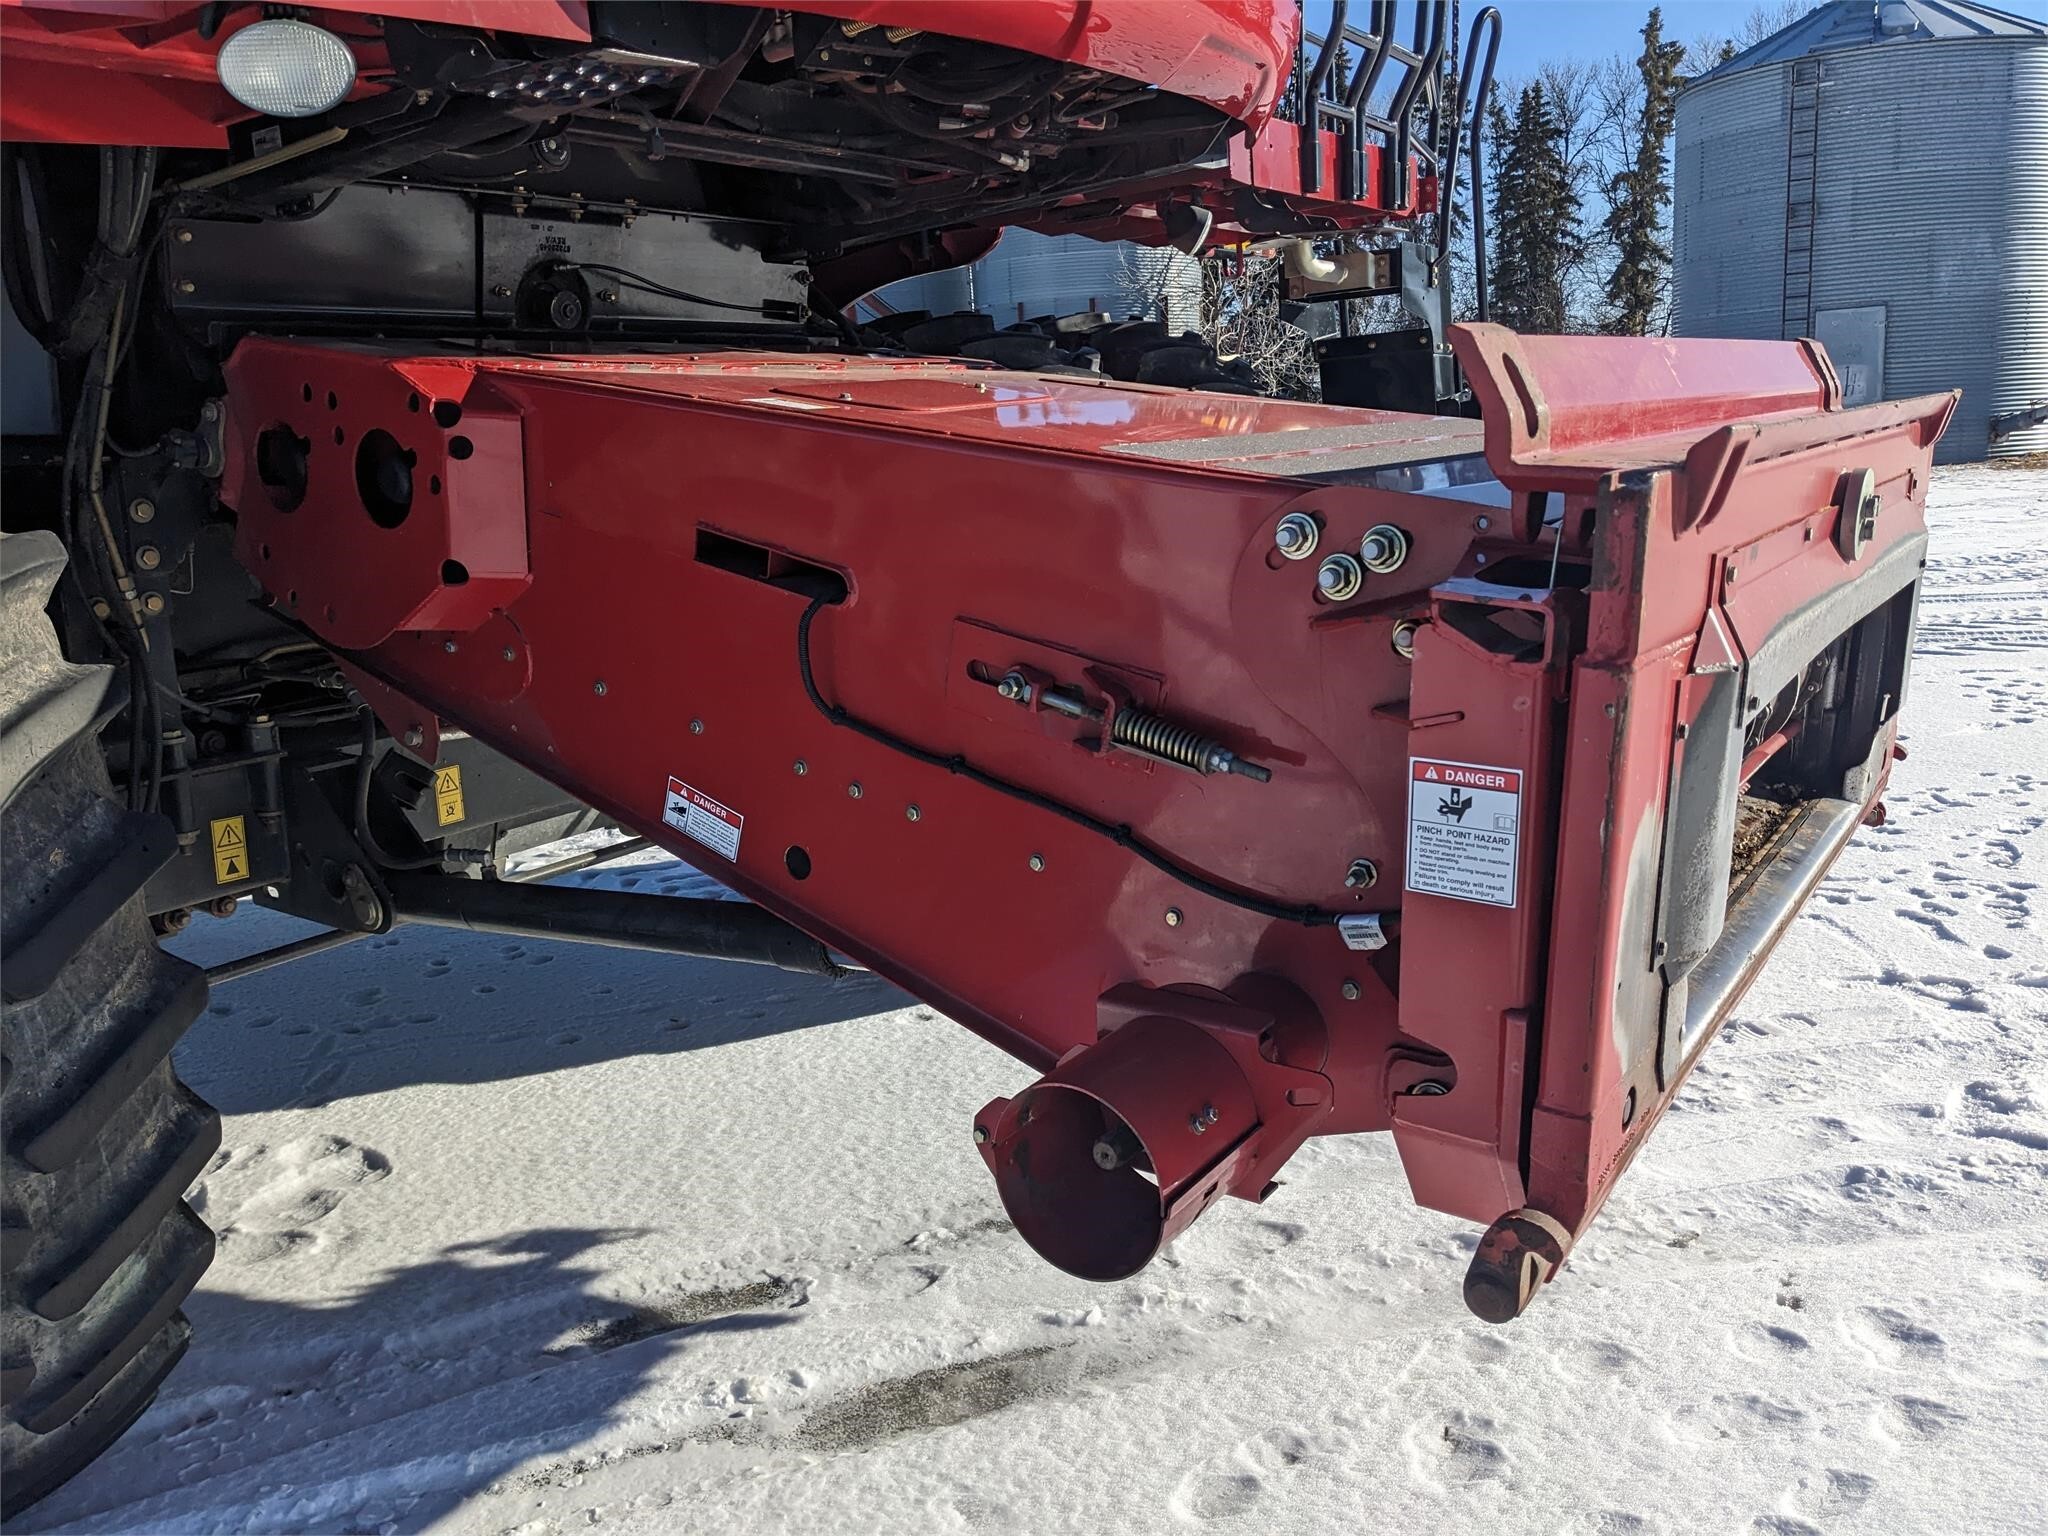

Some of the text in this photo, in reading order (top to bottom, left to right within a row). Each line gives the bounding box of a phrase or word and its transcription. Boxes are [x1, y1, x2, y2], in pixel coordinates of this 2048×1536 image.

[1445, 769, 1505, 788] DANGER
[693, 794, 727, 819] DANGER
[1416, 824, 1510, 846] PINCH POINT HAZARD
[1476, 843, 1490, 851] body
[1419, 860, 1437, 868] Hazard
[1457, 867, 1474, 875] during
[1475, 870, 1496, 878] leveling
[1414, 871, 1437, 881] Failure
[1446, 877, 1471, 888] comply
[1485, 884, 1505, 892] result
[1421, 880, 1440, 889] death
[1449, 885, 1474, 894] serious
[1474, 889, 1495, 899] injury.
